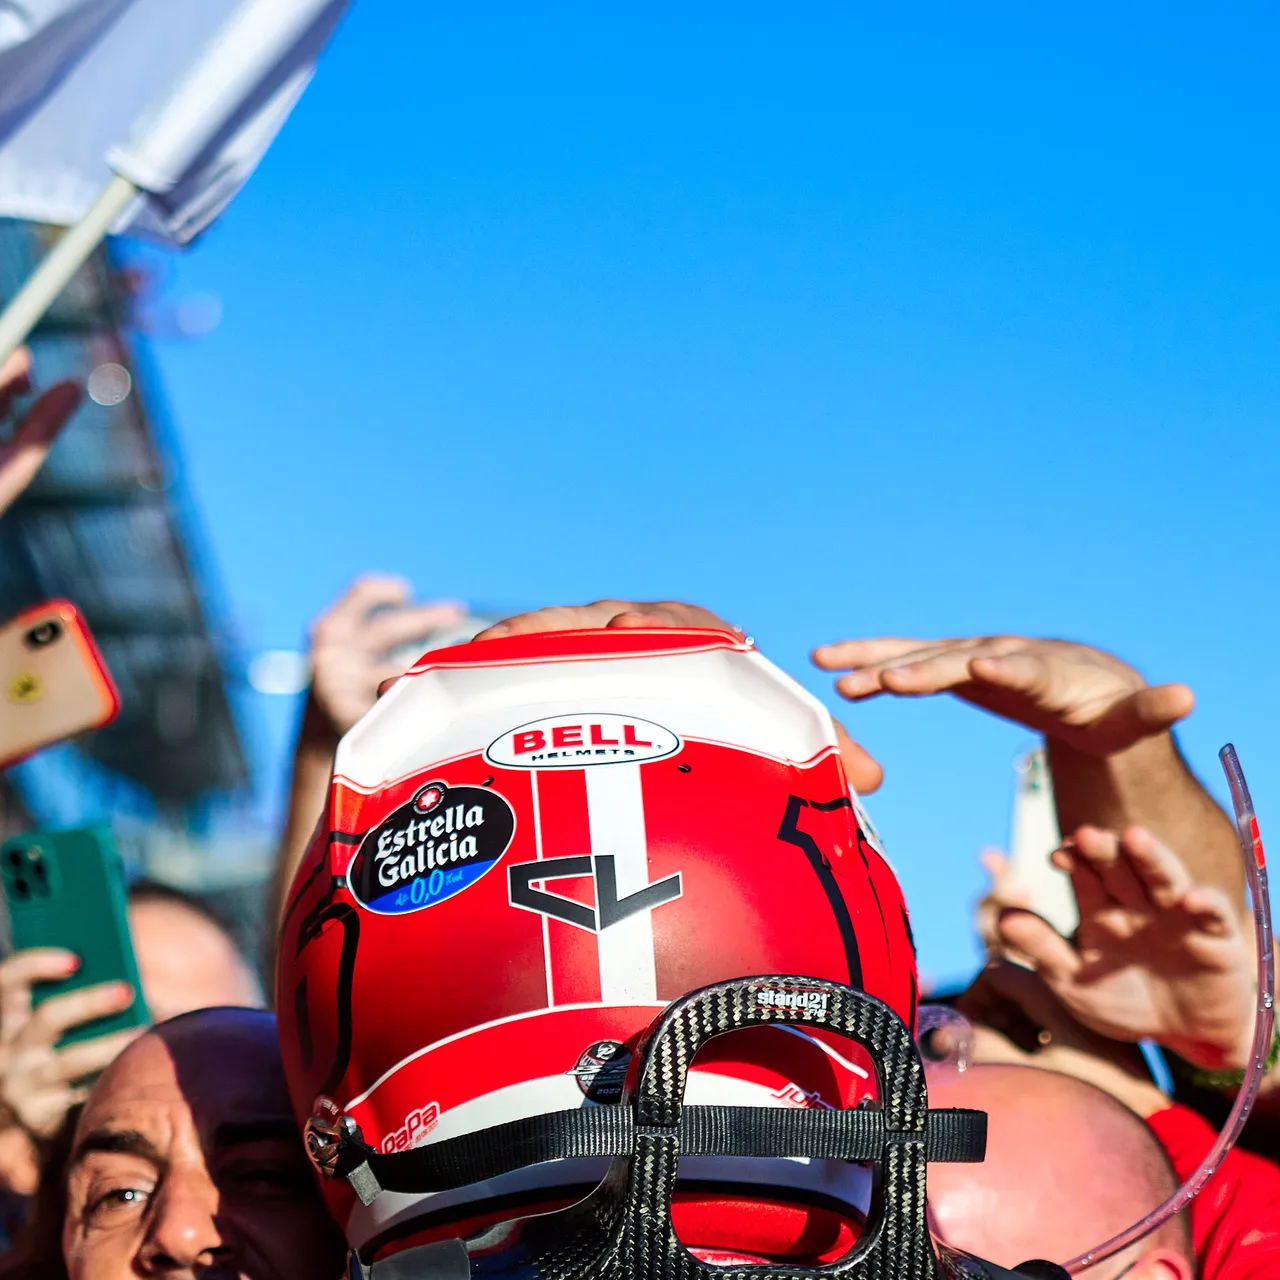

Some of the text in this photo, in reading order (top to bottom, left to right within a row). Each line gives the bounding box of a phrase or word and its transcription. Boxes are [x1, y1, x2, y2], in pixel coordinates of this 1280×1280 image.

[512, 724, 653, 756] BELL
[531, 749, 636, 762] HELMETS
[374, 803, 485, 862] Estrella
[378, 832, 480, 888] Galicia
